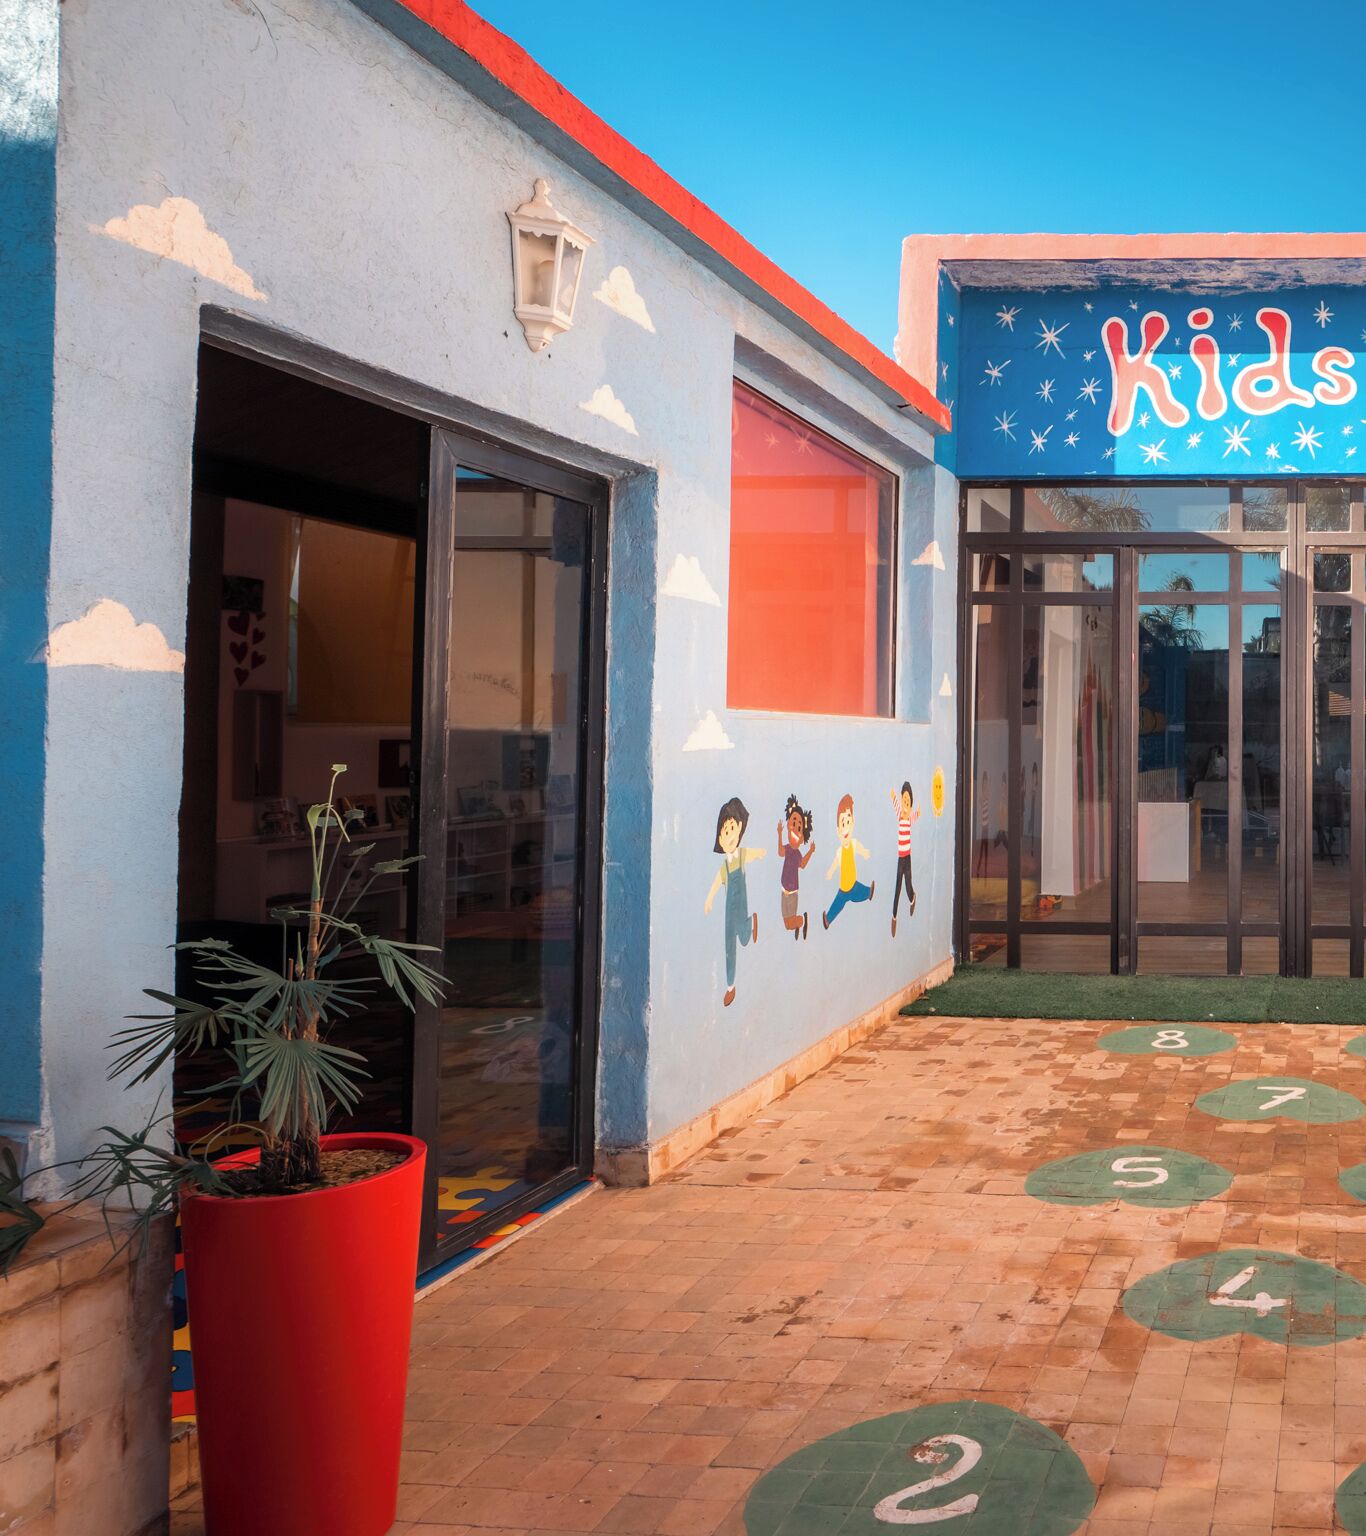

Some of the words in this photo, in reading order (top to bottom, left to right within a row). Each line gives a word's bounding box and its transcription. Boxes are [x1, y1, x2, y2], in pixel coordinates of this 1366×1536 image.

[1101, 307, 1356, 437] Kids
[1150, 1030, 1189, 1049] 8
[1256, 1086, 1306, 1110] 7
[1110, 1157, 1169, 1188] 5
[1208, 1265, 1288, 1318] 4
[873, 1434, 983, 1526] 2
